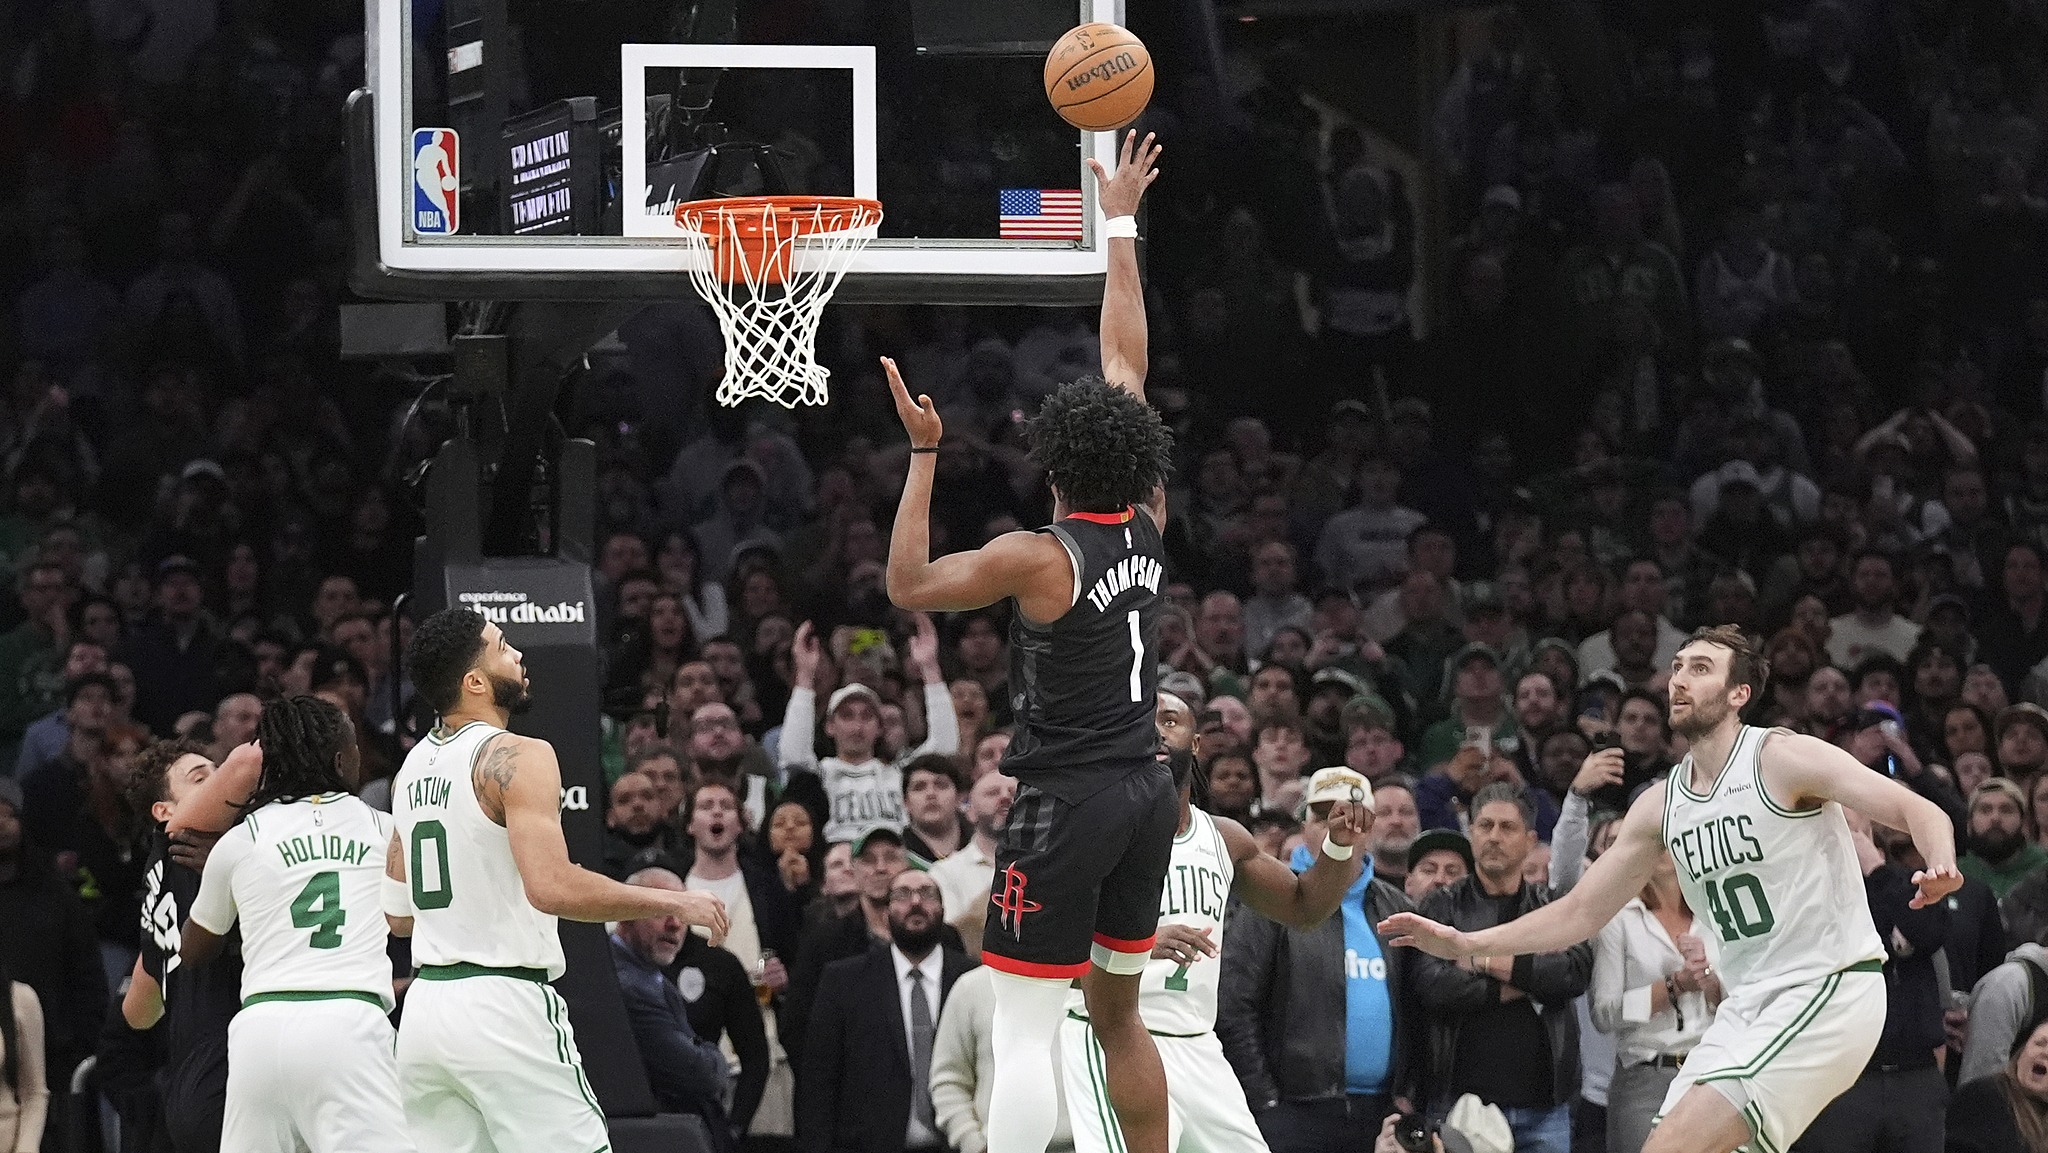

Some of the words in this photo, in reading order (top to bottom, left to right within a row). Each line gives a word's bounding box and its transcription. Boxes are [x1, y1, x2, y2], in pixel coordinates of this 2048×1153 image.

[1066, 52, 1137, 91] Wilson
[419, 211, 440, 228] NBA
[459, 591, 527, 603] experience
[1087, 555, 1162, 613] THOMPSON
[464, 602, 508, 623] bu
[1127, 610, 1144, 702] 1
[407, 776, 452, 811] TATUM
[1724, 783, 1752, 797] Amica
[277, 834, 371, 868] HOLIDAY
[410, 819, 453, 910] 0
[1671, 815, 1764, 882] CELTICS
[290, 871, 346, 949] 4
[1160, 865, 1223, 922] LTICS
[1705, 872, 1775, 941] 40
